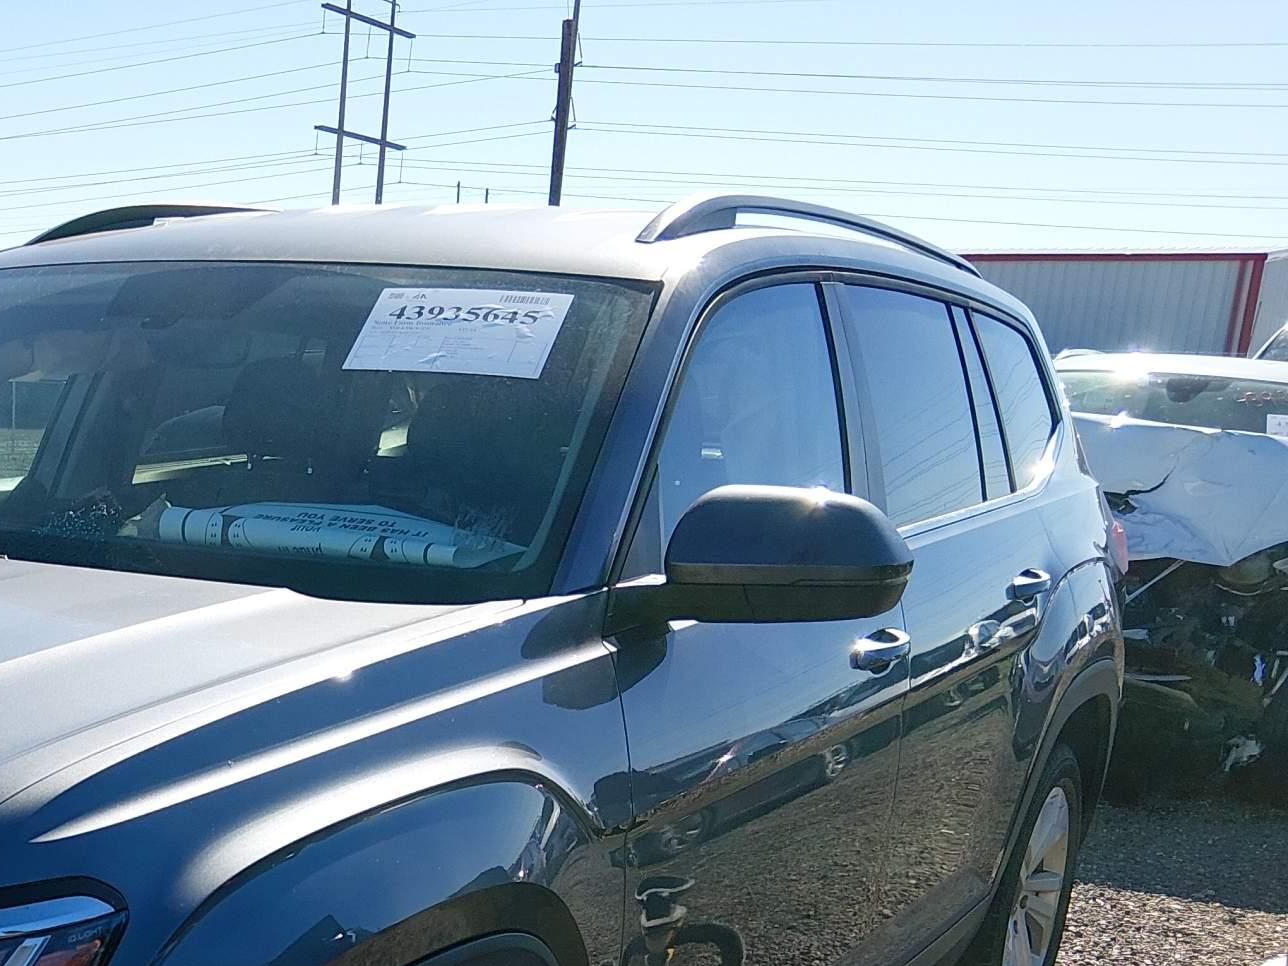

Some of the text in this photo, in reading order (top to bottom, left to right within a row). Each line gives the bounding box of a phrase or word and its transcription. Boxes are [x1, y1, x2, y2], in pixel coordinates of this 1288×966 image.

[388, 304, 542, 325] 43935645
[252, 513, 323, 526] PLEASURE
[295, 511, 398, 528] TO SERVE YOU
[339, 523, 378, 532] BEEN
[380, 527, 410, 536] HAS
[411, 530, 429, 538] IT
